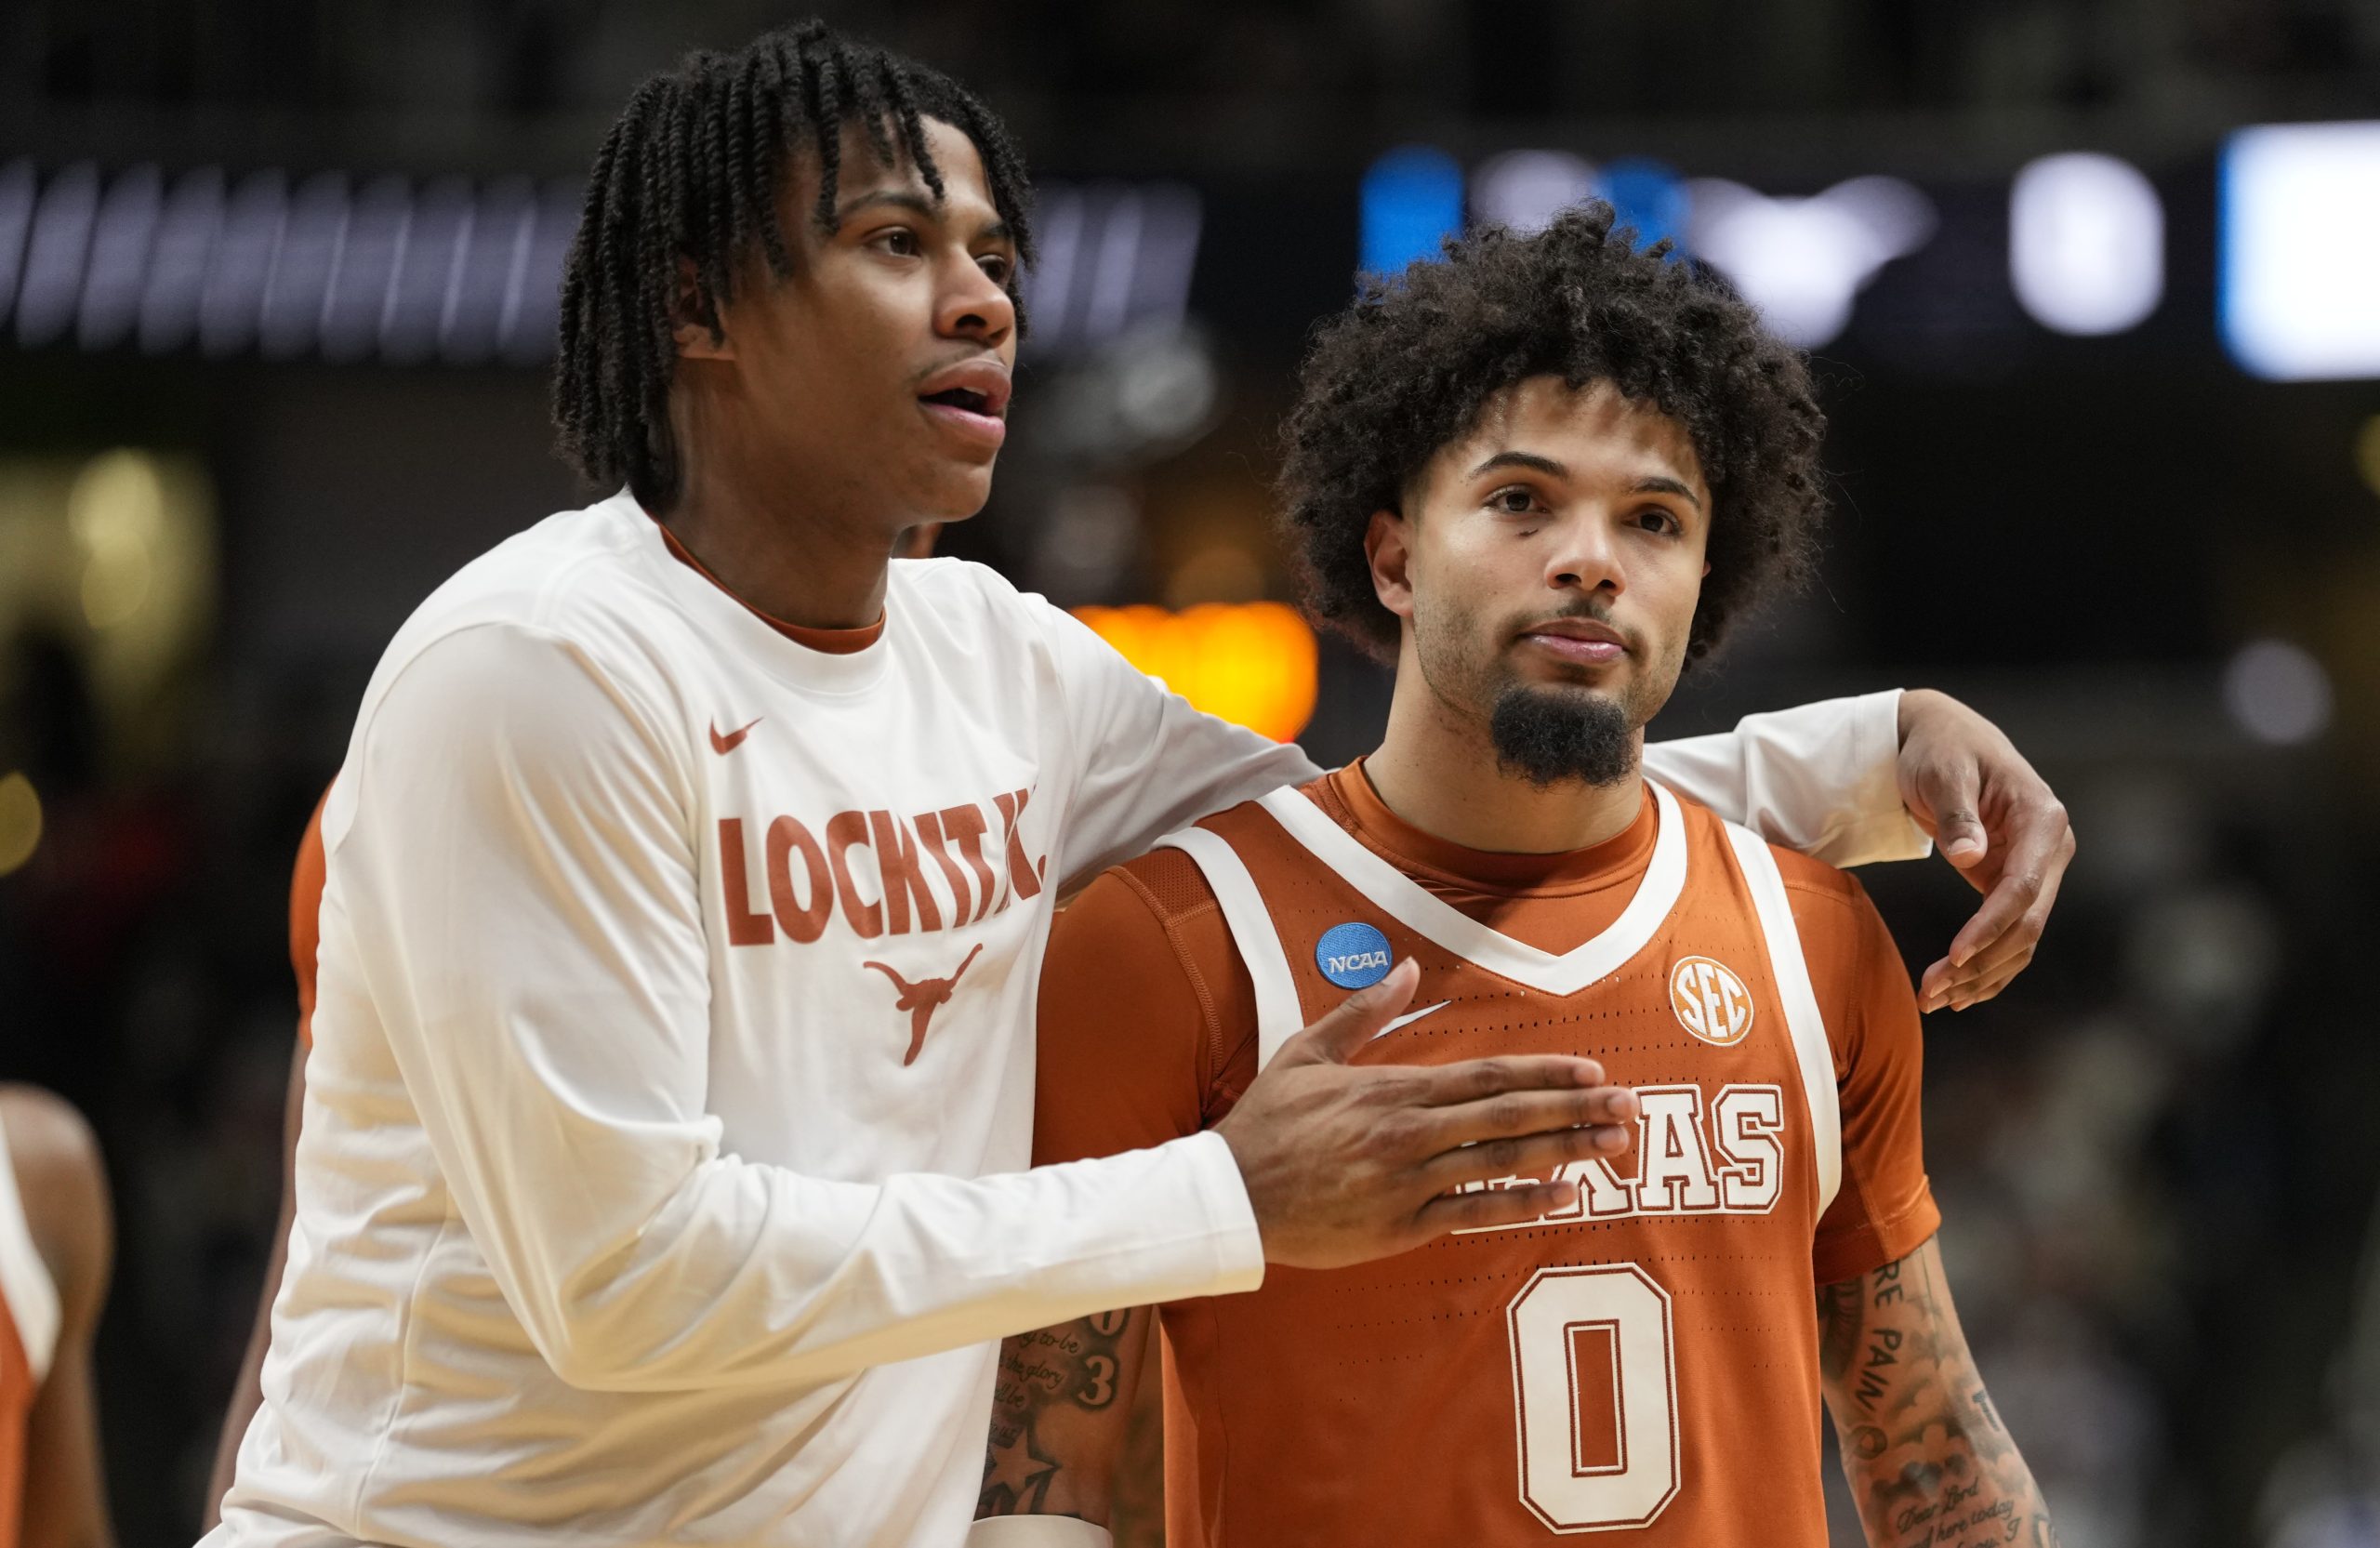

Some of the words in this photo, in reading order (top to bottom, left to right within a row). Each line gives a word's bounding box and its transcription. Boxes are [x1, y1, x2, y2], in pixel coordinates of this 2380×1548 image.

[1329, 951, 1390, 974] NCAA
[1681, 964, 1747, 1039] SEC
[1019, 1359, 1065, 1390] glory
[1506, 1263, 1681, 1535] 0
[1856, 1327, 1903, 1412] PAIN
[1897, 1505, 1937, 1535] Dear
[1942, 1476, 1978, 1514] Lord
[1970, 1498, 2014, 1525] today
